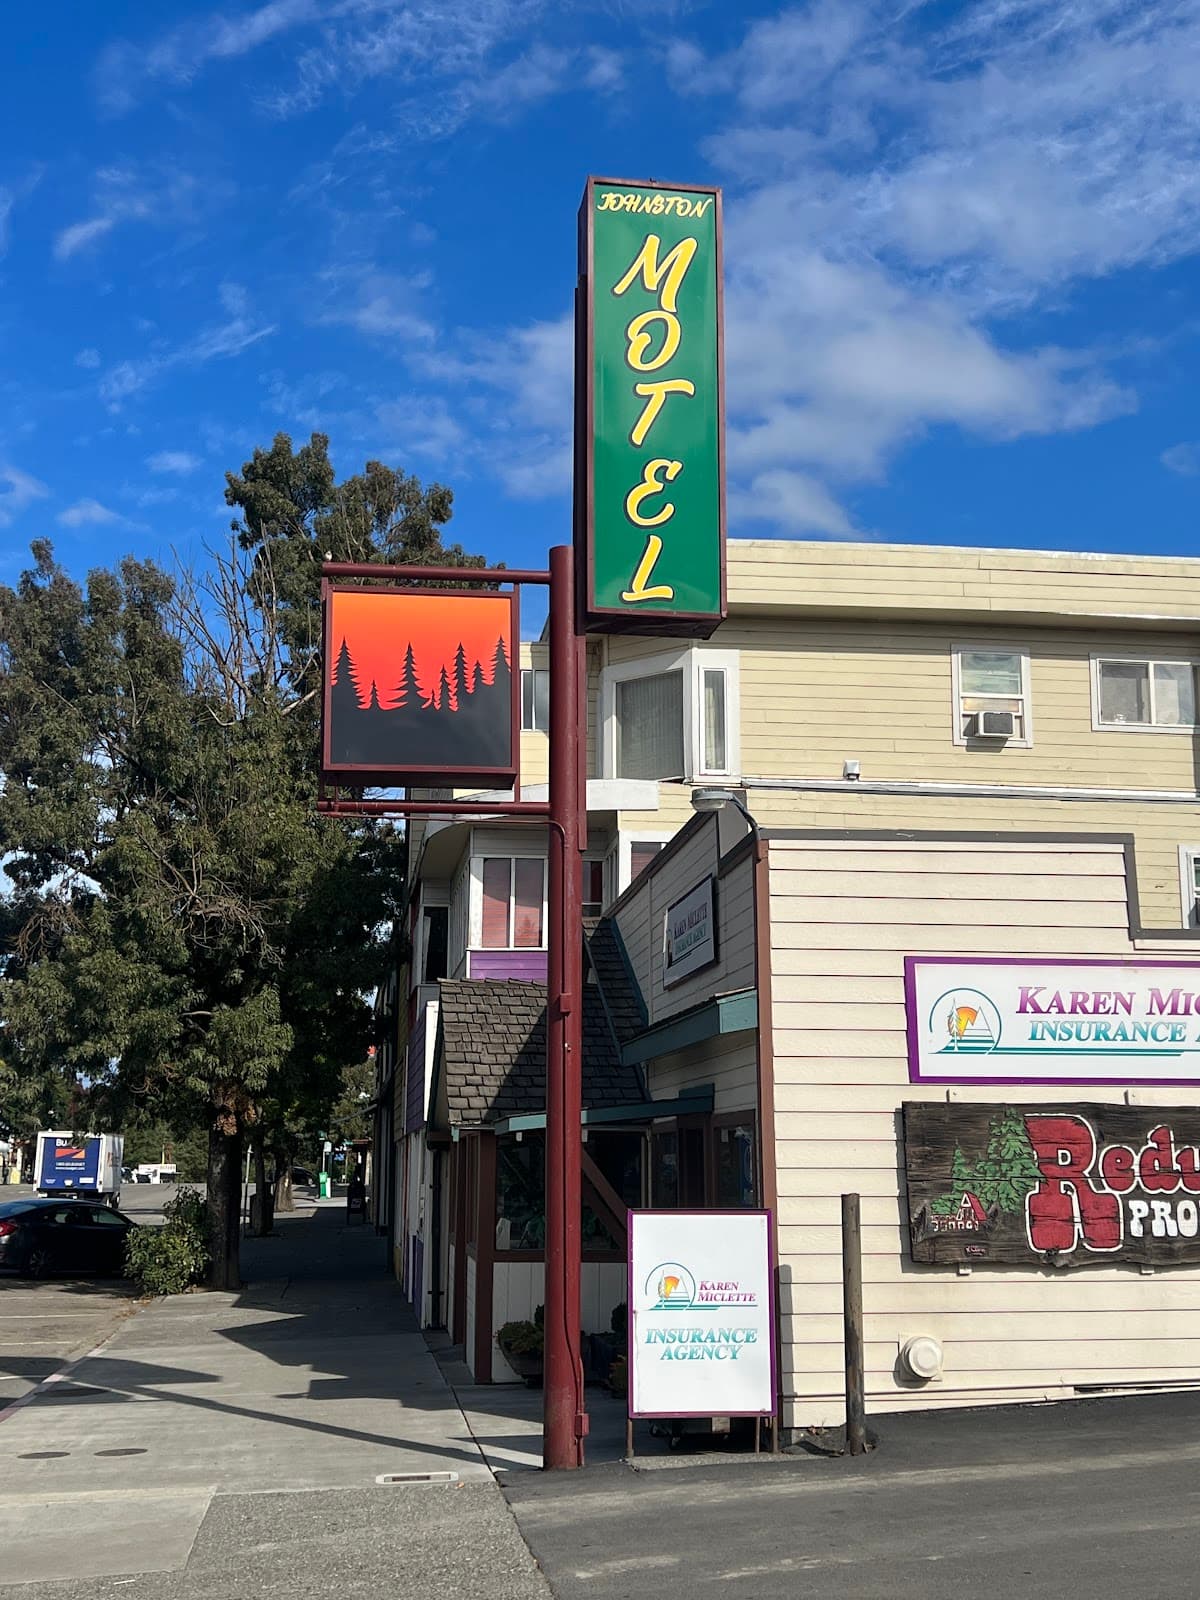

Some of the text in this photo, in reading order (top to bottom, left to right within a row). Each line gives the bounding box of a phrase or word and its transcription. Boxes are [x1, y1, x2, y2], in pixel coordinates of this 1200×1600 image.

[597, 192, 712, 218] JOHNSTON
[612, 233, 698, 603] MOTEL
[1016, 986, 1200, 1016] KAREN MI
[1028, 1020, 1187, 1043] INSURANCE
[1129, 1199, 1200, 1238] PRO
[697, 1292, 756, 1302] MICLETTE
[699, 1280, 739, 1291] KAREN
[645, 1328, 758, 1344] INSURANCE
[660, 1344, 744, 1361] AGENCY
